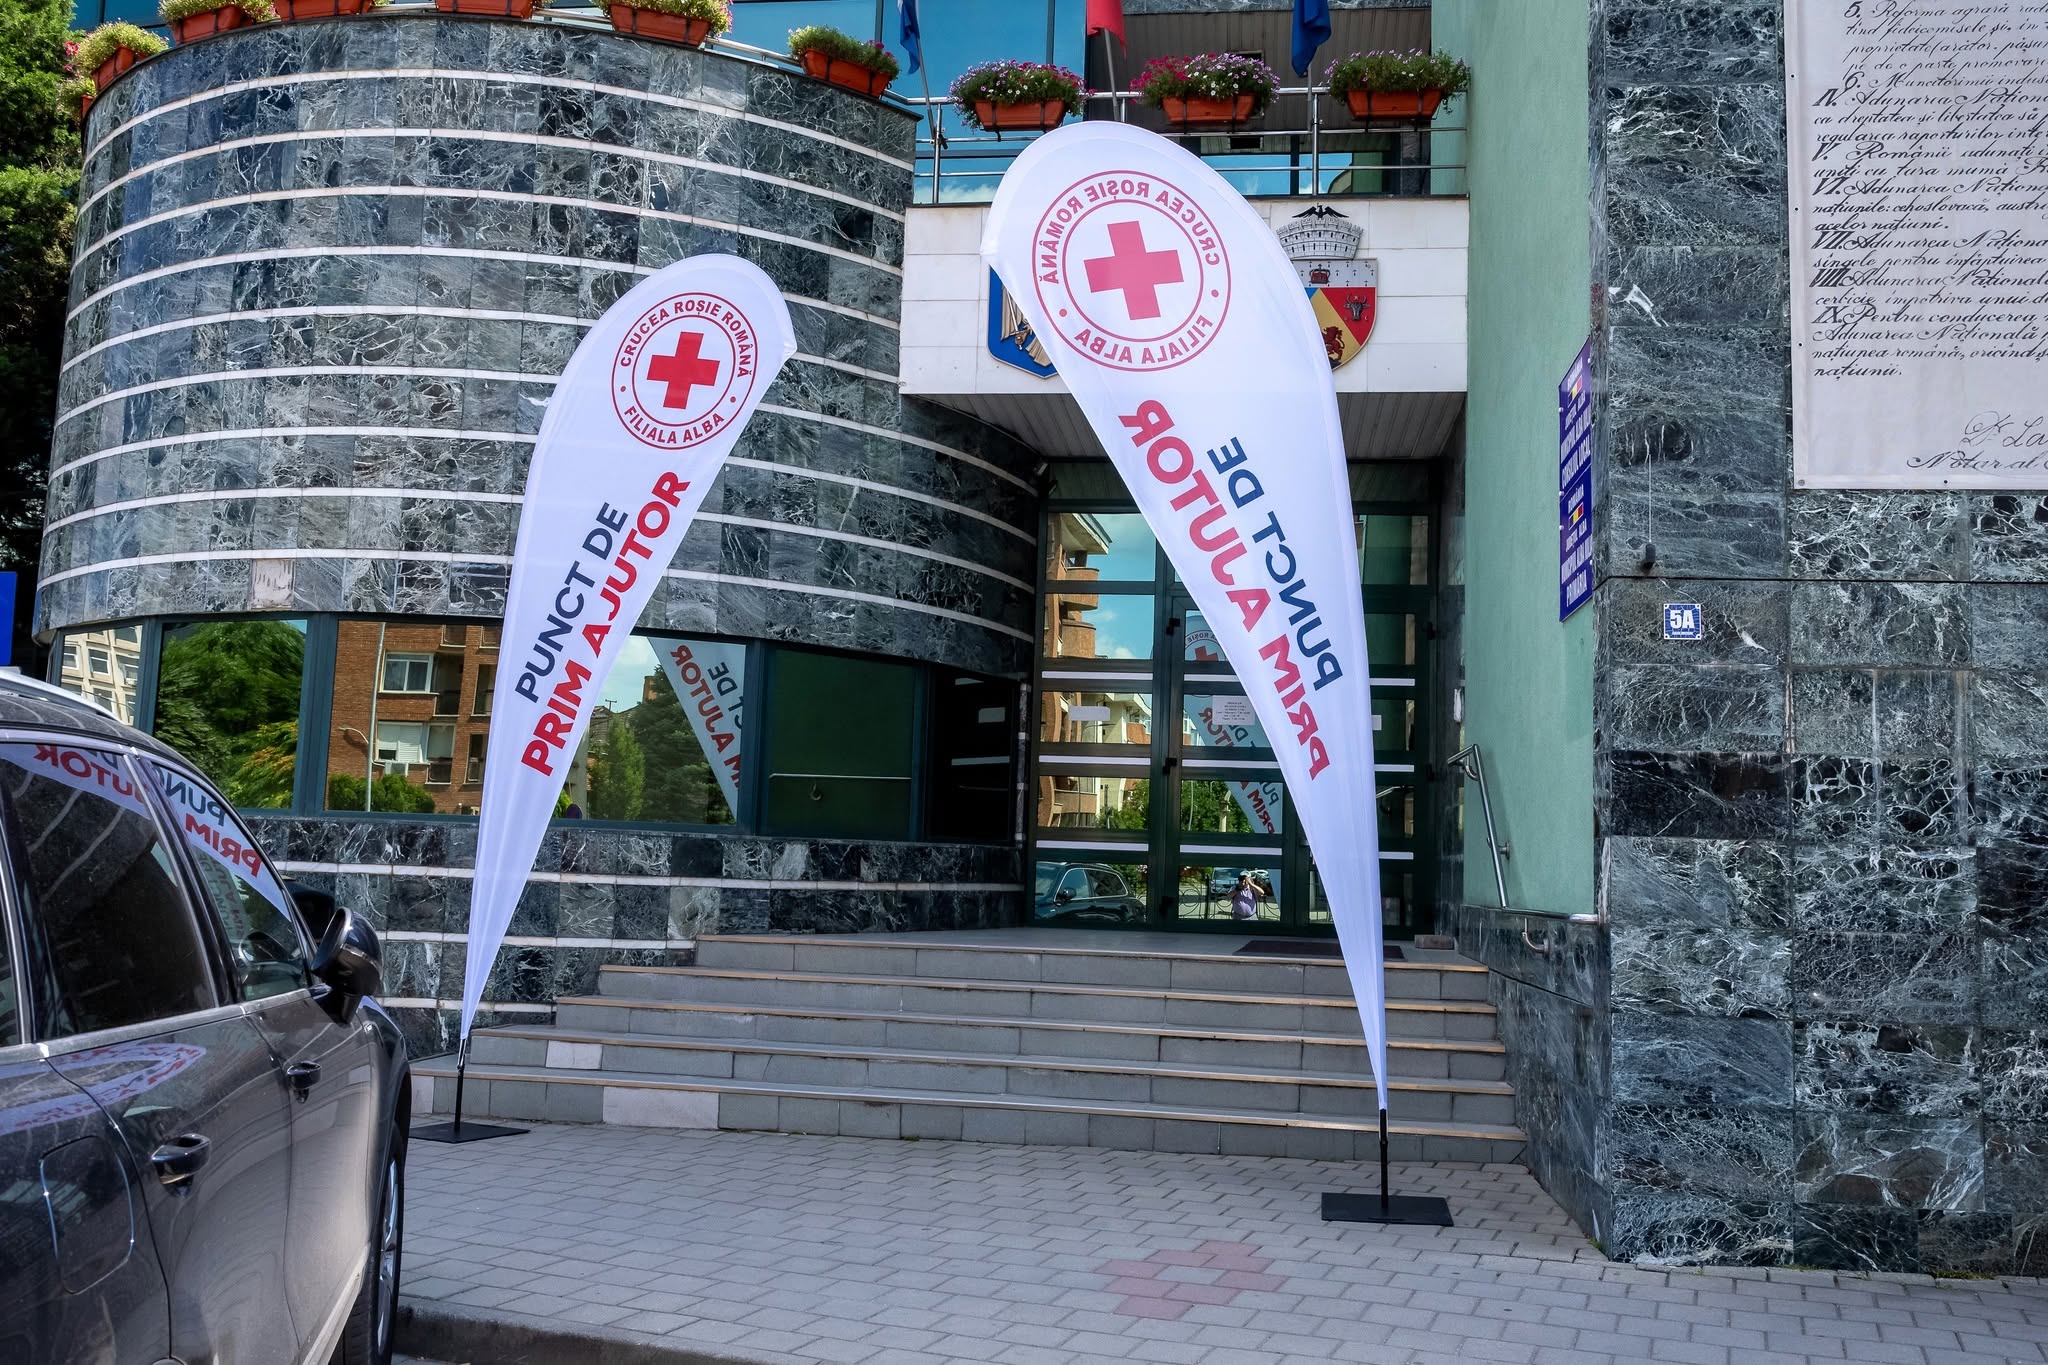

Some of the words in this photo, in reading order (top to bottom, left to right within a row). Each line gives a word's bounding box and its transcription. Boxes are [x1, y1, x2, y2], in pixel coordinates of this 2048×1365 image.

[1845, 71, 1865, 90] 6.
[1846, 88, 1952, 106] Adunarea
[1938, 103, 2014, 121] libertatea
[1812, 142, 1842, 161] V.
[1846, 140, 1952, 160] Românii
[1812, 176, 1850, 195] VI.
[1844, 176, 1951, 195] Adunarea
[1813, 213, 1867, 231] acelor
[1811, 231, 1855, 249] VII.
[1843, 231, 1951, 250] Adunarea
[1841, 266, 1941, 287] Adunarea
[1811, 305, 1849, 323] IX.
[1843, 303, 1925, 324] Pentru
[1928, 304, 2037, 323] conducerea
[620, 308, 670, 367] CRUCEA
[674, 300, 722, 316] ROȘIE
[721, 311, 754, 378] ROMÂNĂ
[1813, 322, 1914, 341] Adunarea
[624, 406, 677, 444] FILIALA
[682, 413, 724, 442] ALBA
[514, 561, 595, 703] PUNCT
[582, 502, 628, 560] DE
[521, 659, 592, 777] PRIM
[582, 471, 691, 658] AJUTOR
[1670, 610, 1695, 629] 5A
